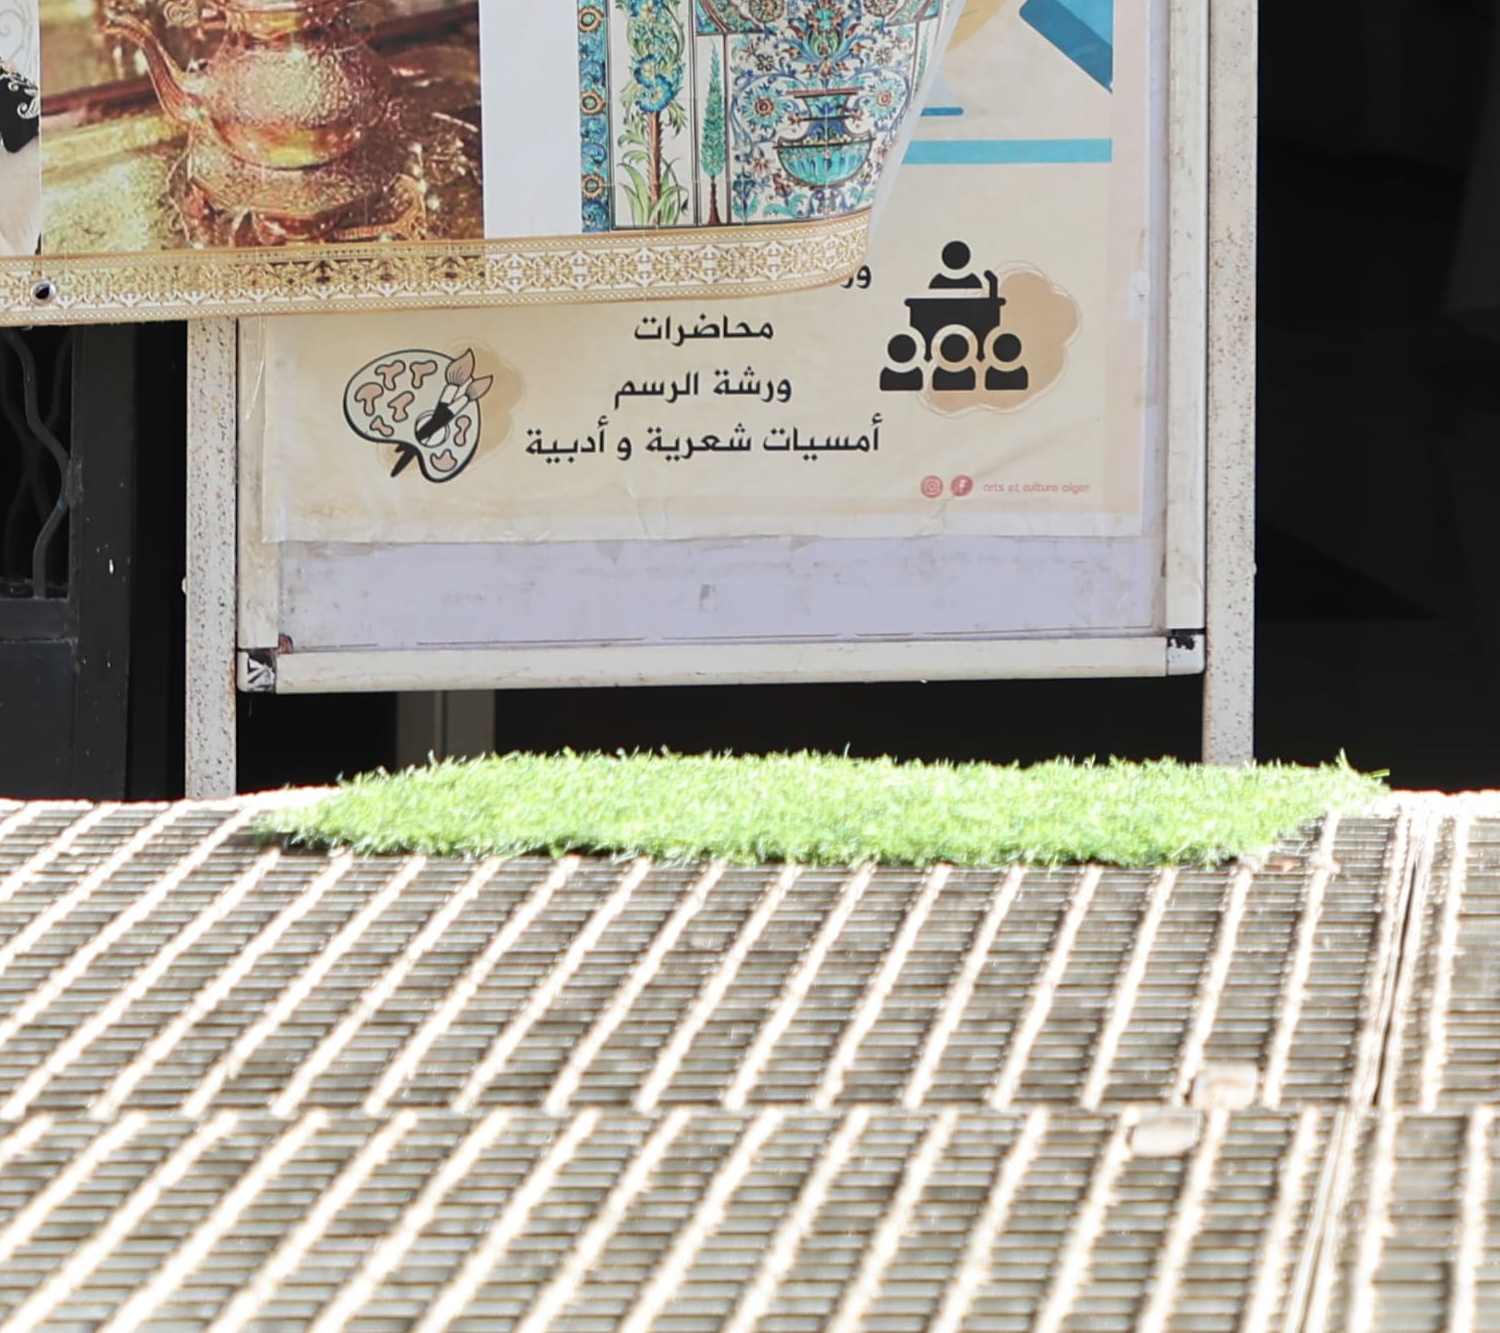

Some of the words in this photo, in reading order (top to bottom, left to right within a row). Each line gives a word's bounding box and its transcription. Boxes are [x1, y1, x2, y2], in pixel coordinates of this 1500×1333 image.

[633, 313, 774, 347] محاضرات
[614, 371, 699, 410] الرسم
[713, 365, 792, 402] ورشة
[525, 414, 609, 464] أدبية
[616, 436, 632, 461] و
[645, 422, 752, 462] شعرية
[762, 412, 883, 462] أمسيات
